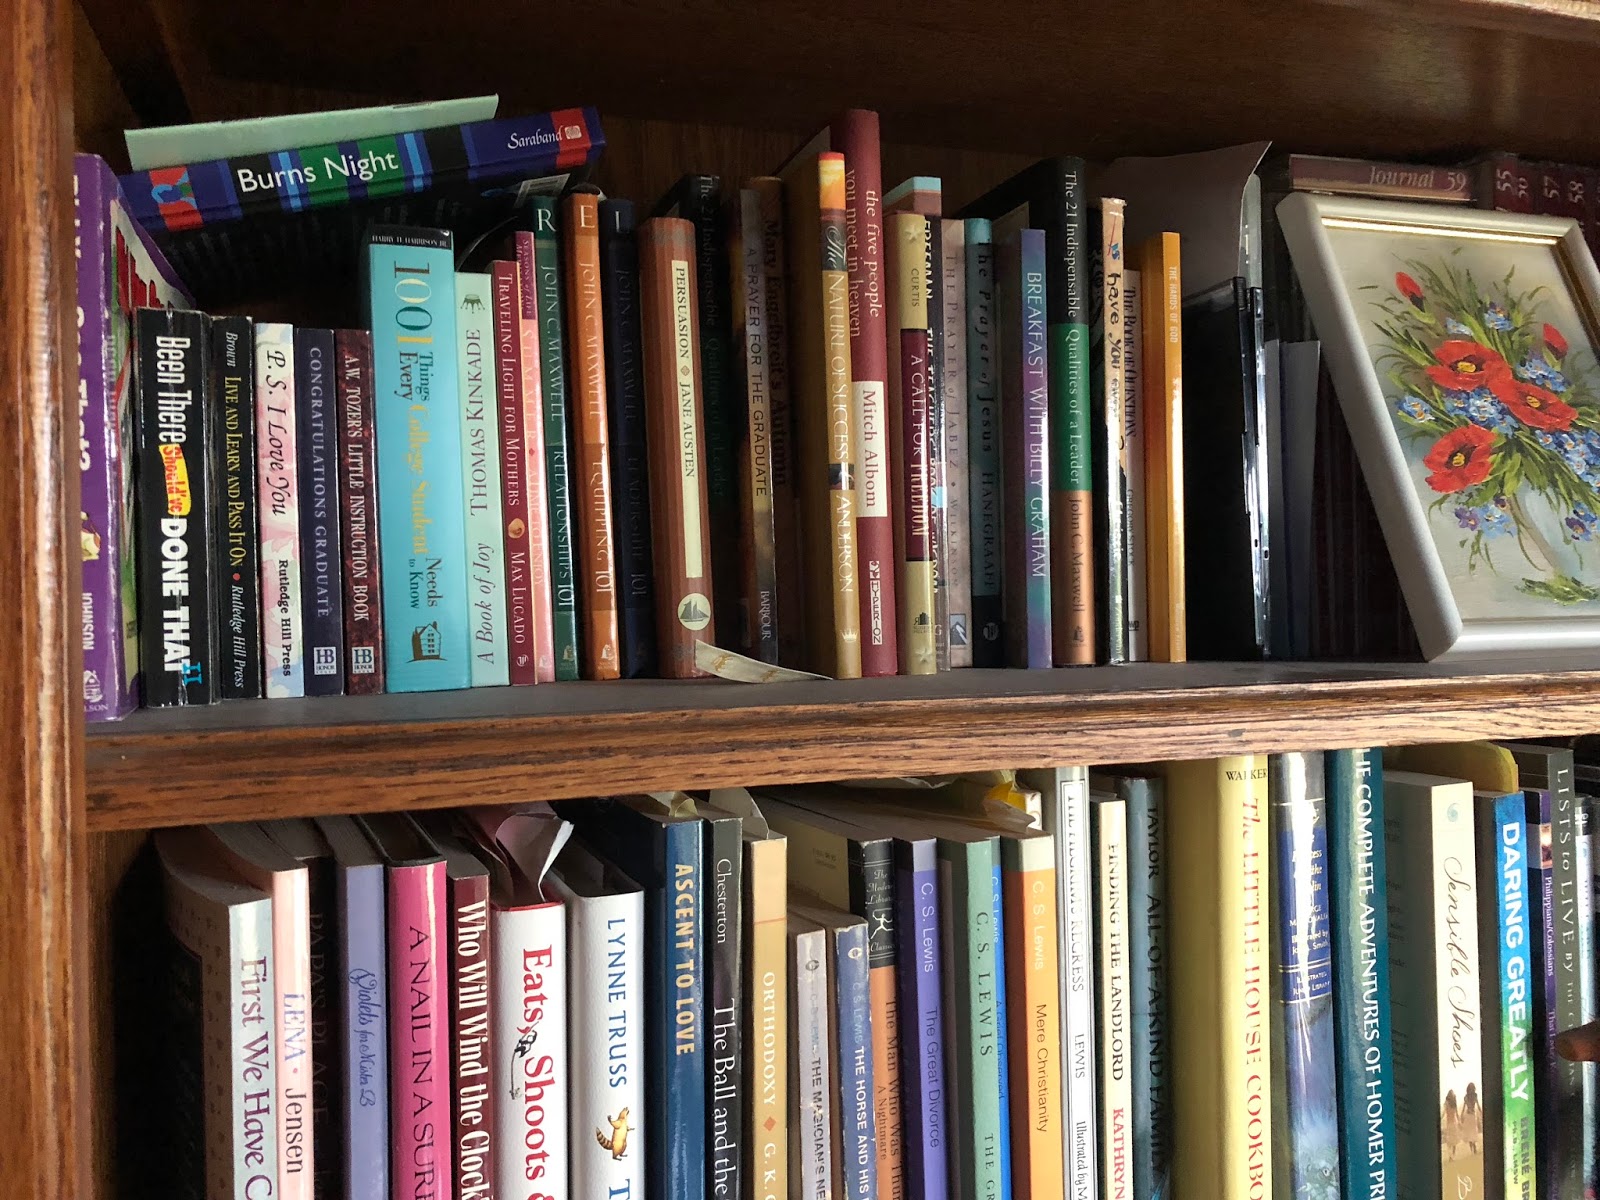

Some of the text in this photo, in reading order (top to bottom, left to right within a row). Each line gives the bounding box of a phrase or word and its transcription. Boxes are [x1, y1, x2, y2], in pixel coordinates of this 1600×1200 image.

[238, 150, 398, 194] Burns Night
[507, 127, 563, 150] Saraband
[1369, 165, 1434, 188] Journal
[1496, 168, 1512, 191] 55
[1568, 181, 1584, 203] 58
[538, 208, 556, 232] R
[580, 204, 595, 228] E
[864, 190, 882, 318] the five people
[226, 332, 240, 366] Brown
[676, 266, 696, 478] PERSUASION JANE AUSTEN
[910, 268, 924, 414] CURTIS CALL
[944, 254, 960, 468] THE PRAYER JABEZ
[976, 290, 996, 452] Prayer Jesus
[1106, 272, 1123, 324] have
[1169, 284, 1180, 344] HANDS GOD
[394, 352, 416, 401] Every
[416, 352, 434, 402] Things
[466, 330, 488, 516] THOMAS KINKADE
[540, 266, 576, 606] JOHN MAXWELL RELATIONSHIPS 101
[578, 262, 613, 592] JOHN MAXWELL 101
[746, 248, 774, 640] A PRAYER FOR THE GRADUATE BARBOUR
[828, 273, 854, 592] NATURE SUCCESS ANDERSON
[862, 390, 882, 508] Mitch Albom
[1027, 272, 1046, 578] BREAKFAST WITH BILLY GRAHAM
[1064, 170, 1086, 614] The 21 Indispensable Qualities of a Leader John Maxwell
[156, 336, 193, 597] Been There DONE
[270, 476, 290, 516] You
[308, 347, 330, 618] CONGRATULATIONS GRADUATE
[346, 387, 370, 622] TOZER'S LITTLE INSTRUCTION BOOK
[497, 274, 527, 644] TRAVELING LIGHT FOR MOTHERS MAX LUCADO
[275, 559, 293, 678] Rutledge Hill Press
[408, 570, 423, 610] Know
[425, 557, 444, 608] Needs
[475, 542, 495, 642] Book of Joy
[870, 582, 882, 644] HYPERION
[976, 912, 990, 932] C.
[1544, 876, 1555, 976] Philippians/Colossians
[1556, 768, 1575, 942] LISTS to LIVE
[410, 926, 434, 1117] A NAIL IN A
[457, 900, 488, 1126] Who Will Wind the
[607, 918, 628, 1088] LYNNE TRUSS
[674, 864, 696, 1056] ASCENT TO LOVE
[920, 882, 942, 1148] C. S. Lewis The Great Divorce
[978, 942, 990, 960] S.
[978, 972, 994, 1056] LEWIS
[1110, 930, 1126, 1080] THE LANDLORD
[1243, 850, 1262, 1064] LITTLE HOUSE
[1356, 784, 1384, 1166] COMPLETE ADVENTURES OF HOMER
[1442, 856, 1475, 1068] Sensible Shoes
[1501, 822, 1529, 1100] DARING GREATLY
[240, 956, 271, 1168] First We Have
[283, 993, 308, 1174] LENA Jensen
[713, 858, 736, 1195] Chesterton The Ball and the
[762, 972, 776, 1164] ORTHODOXY G.
[810, 1057, 822, 1087] THE
[1034, 926, 1050, 1133] Lewis Mere Christianity
[524, 1055, 556, 1181] Shoots
[854, 1046, 869, 1192] THE HORSE AND HIS
[876, 1095, 888, 1160] Nightmare
[888, 1079, 900, 1124] Who
[984, 1132, 996, 1170] THE
[1073, 1033, 1088, 1186] LEWIS Illustrated by
